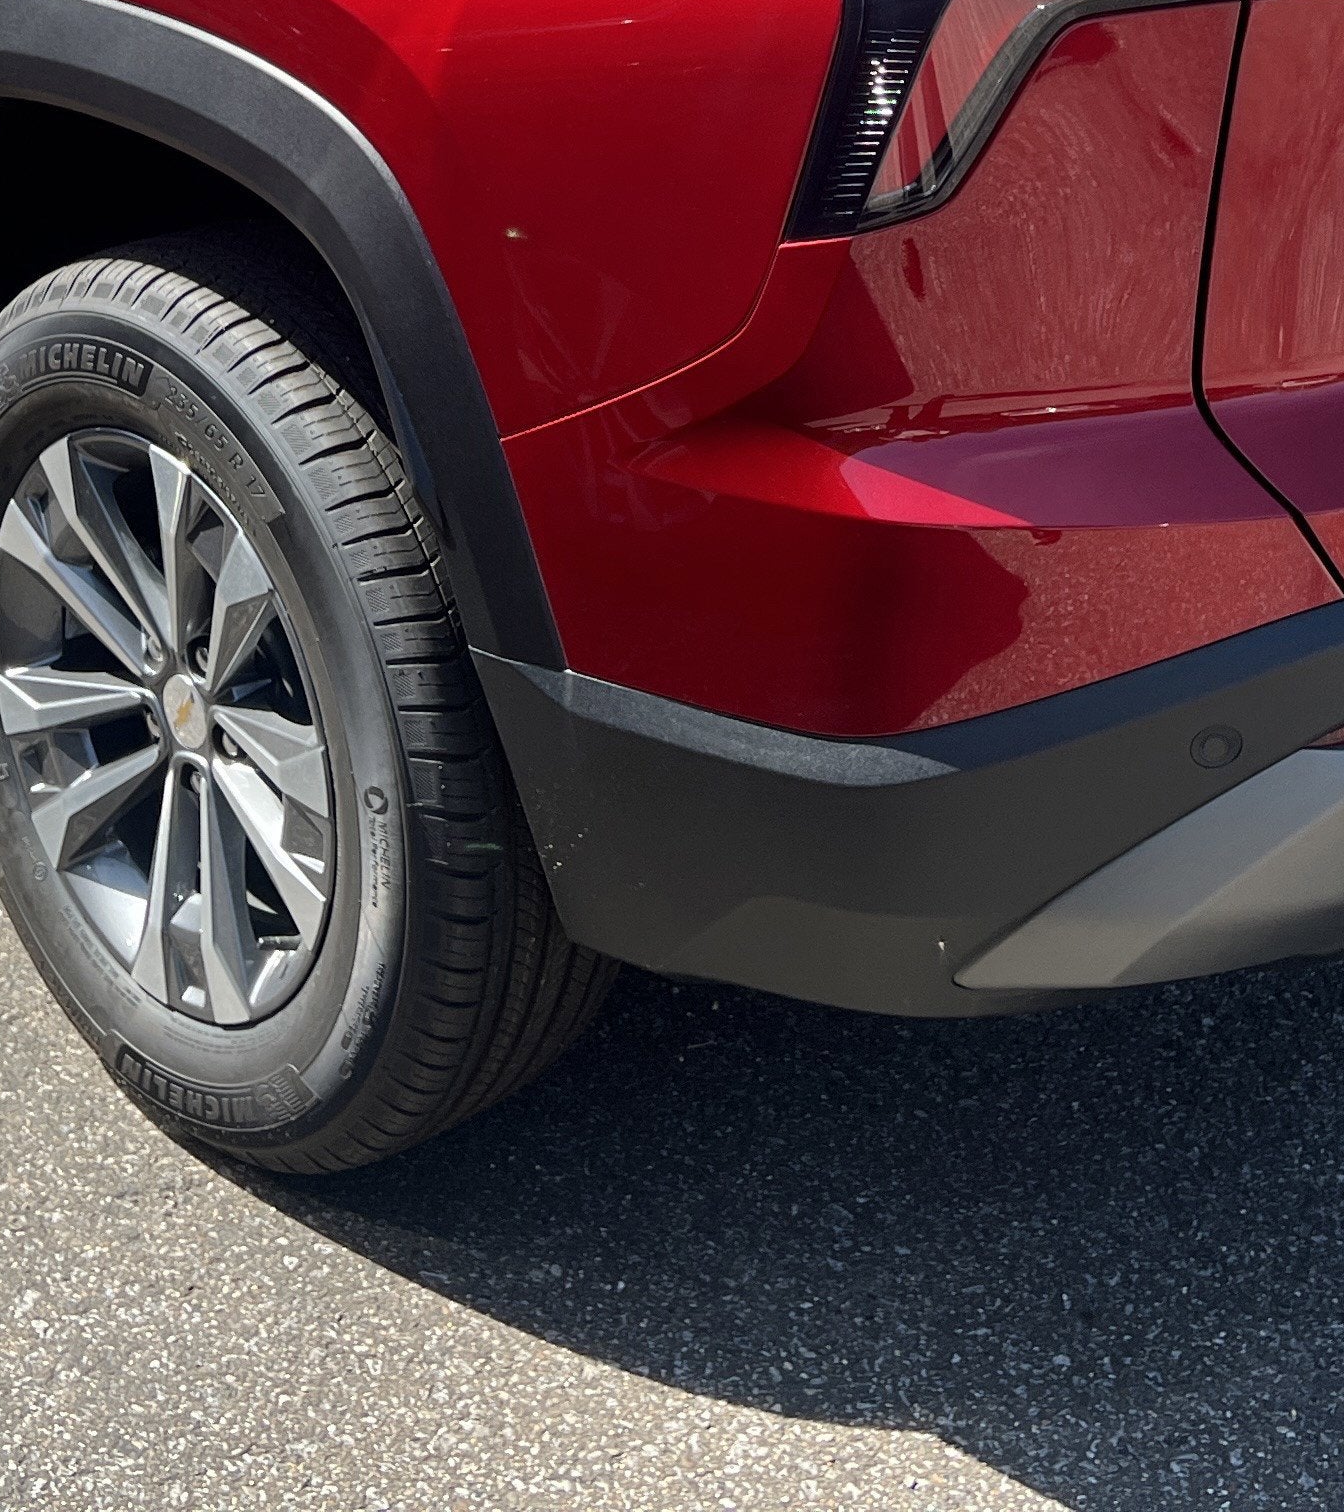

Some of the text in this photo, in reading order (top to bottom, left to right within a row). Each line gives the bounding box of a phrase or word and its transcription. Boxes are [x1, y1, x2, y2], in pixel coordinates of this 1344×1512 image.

[19, 342, 145, 389] MICHELIN
[164, 387, 267, 497] 235/65 R 17
[378, 819, 391, 890] MICHELIN
[120, 1053, 256, 1123] MICHELIN
